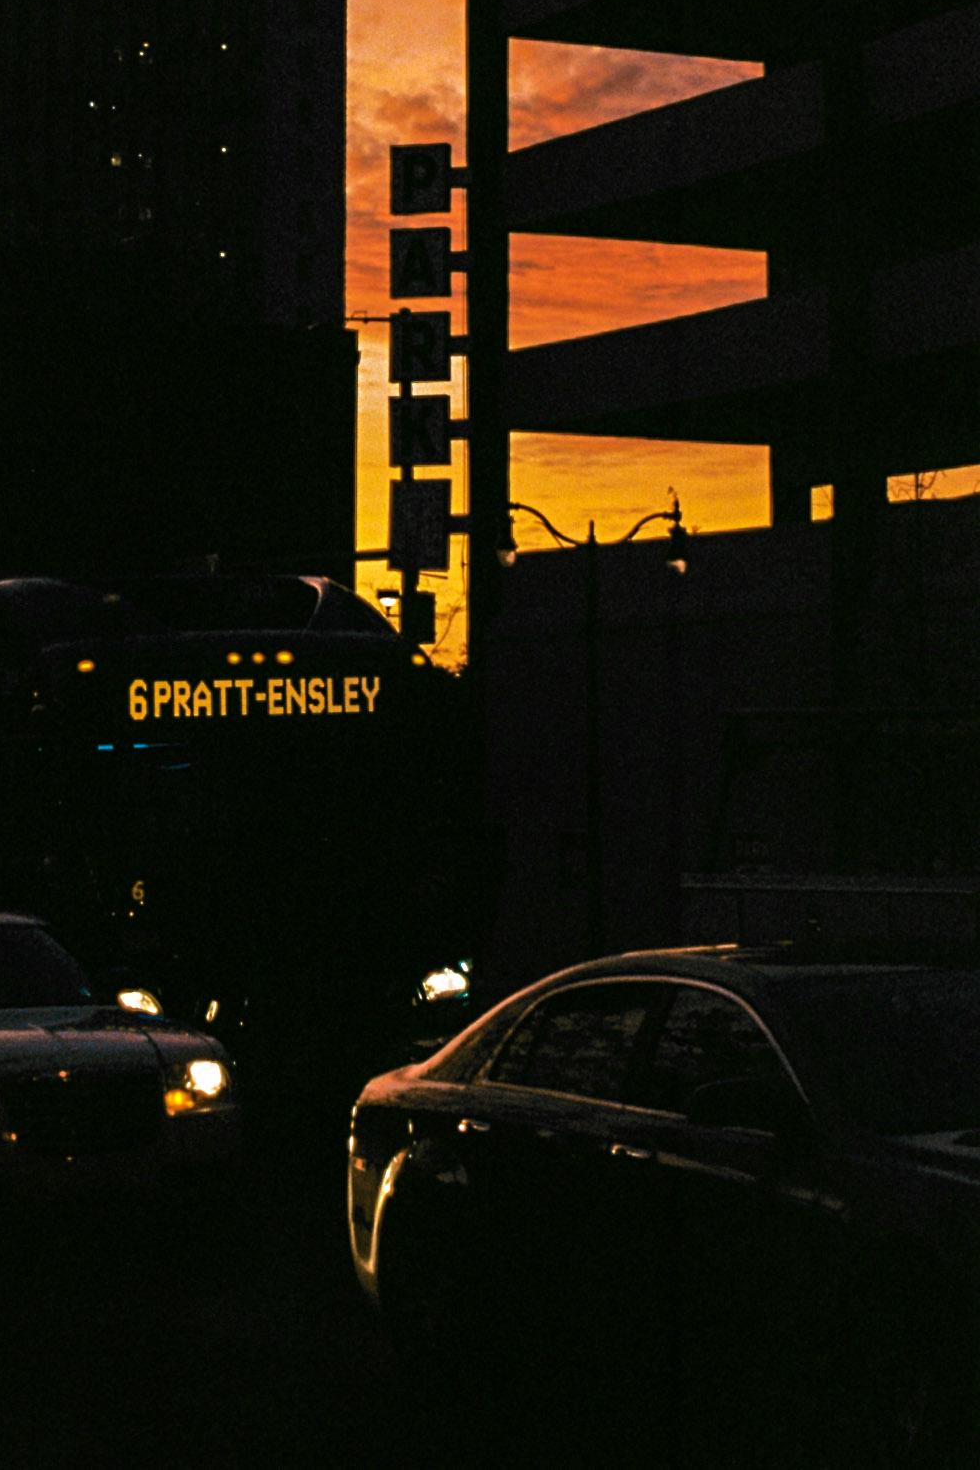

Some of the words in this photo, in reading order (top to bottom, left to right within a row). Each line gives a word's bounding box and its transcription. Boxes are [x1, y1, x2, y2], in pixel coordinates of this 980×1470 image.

[129, 679, 147, 720] 6
[154, 677, 380, 718] PRATT-ENSLEY
[130, 880, 146, 901] 6
